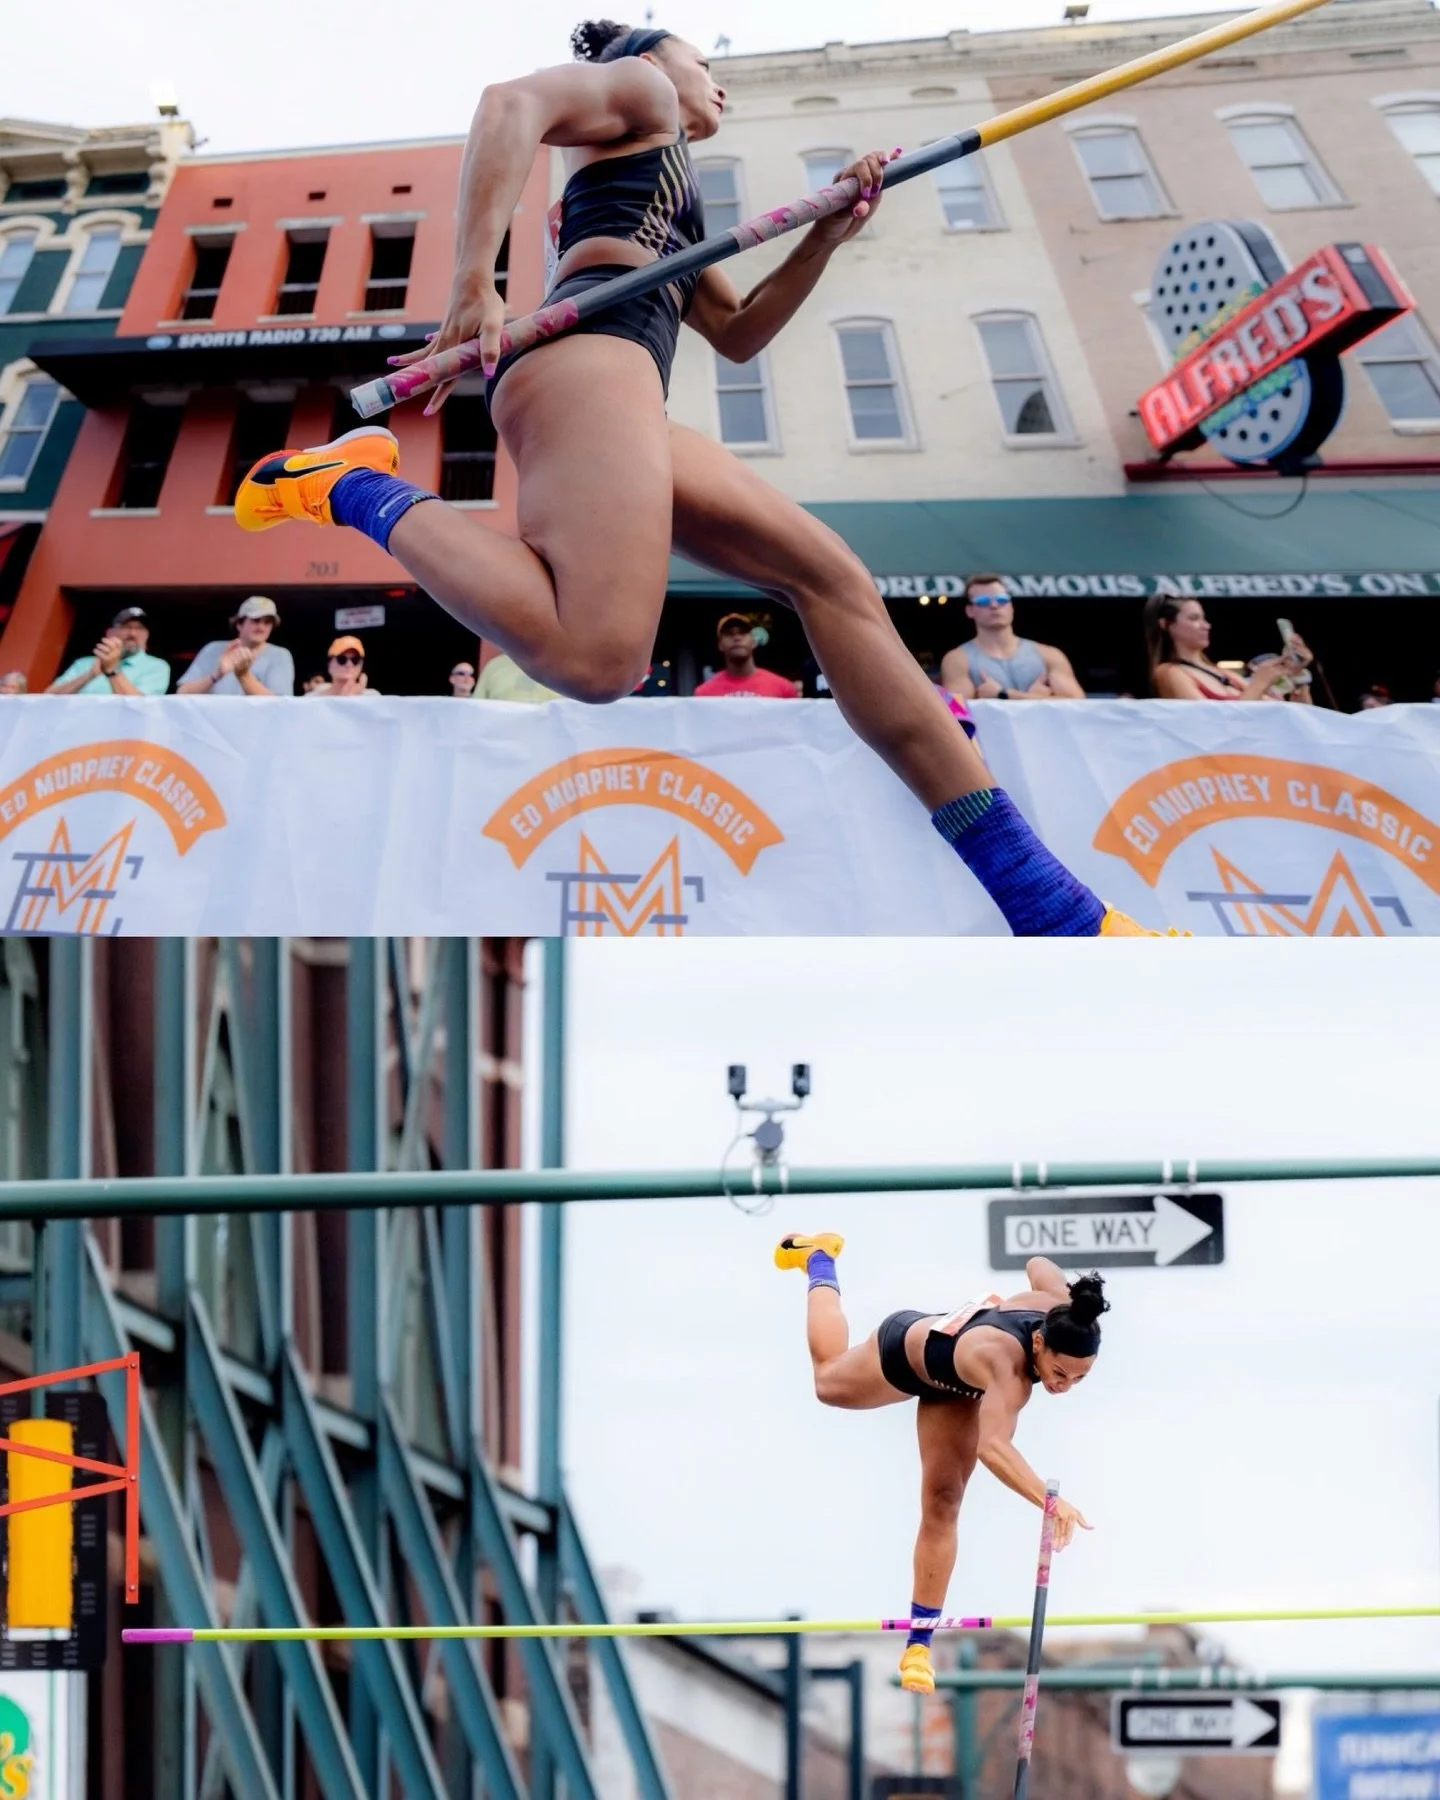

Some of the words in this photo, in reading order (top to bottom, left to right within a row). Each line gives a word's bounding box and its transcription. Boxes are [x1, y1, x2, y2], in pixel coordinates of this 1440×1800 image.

[178, 332, 248, 349] SPORTS
[250, 329, 305, 346] RADIO
[308, 326, 340, 343] 730
[342, 325, 373, 340] AM
[1143, 265, 1344, 449] ALFRED'S
[999, 573, 1146, 598] AMOUS
[1153, 573, 1351, 598] ALFRED'S
[1359, 572, 1430, 596] ON
[0, 789, 28, 823] ED
[33, 755, 135, 800] MURPHEY
[134, 759, 207, 830] CLASSIC
[510, 803, 543, 840] ED
[541, 764, 651, 814] MURPHEY
[658, 770, 757, 846] CLASSIC
[1123, 815, 1161, 855] ED
[1148, 773, 1271, 826] MURPHEY
[1286, 780, 1433, 862] CLASSIC
[1016, 1219, 1077, 1249] ONE
[1092, 1216, 1155, 1247] WAY
[911, 1617, 963, 1628] GILL
